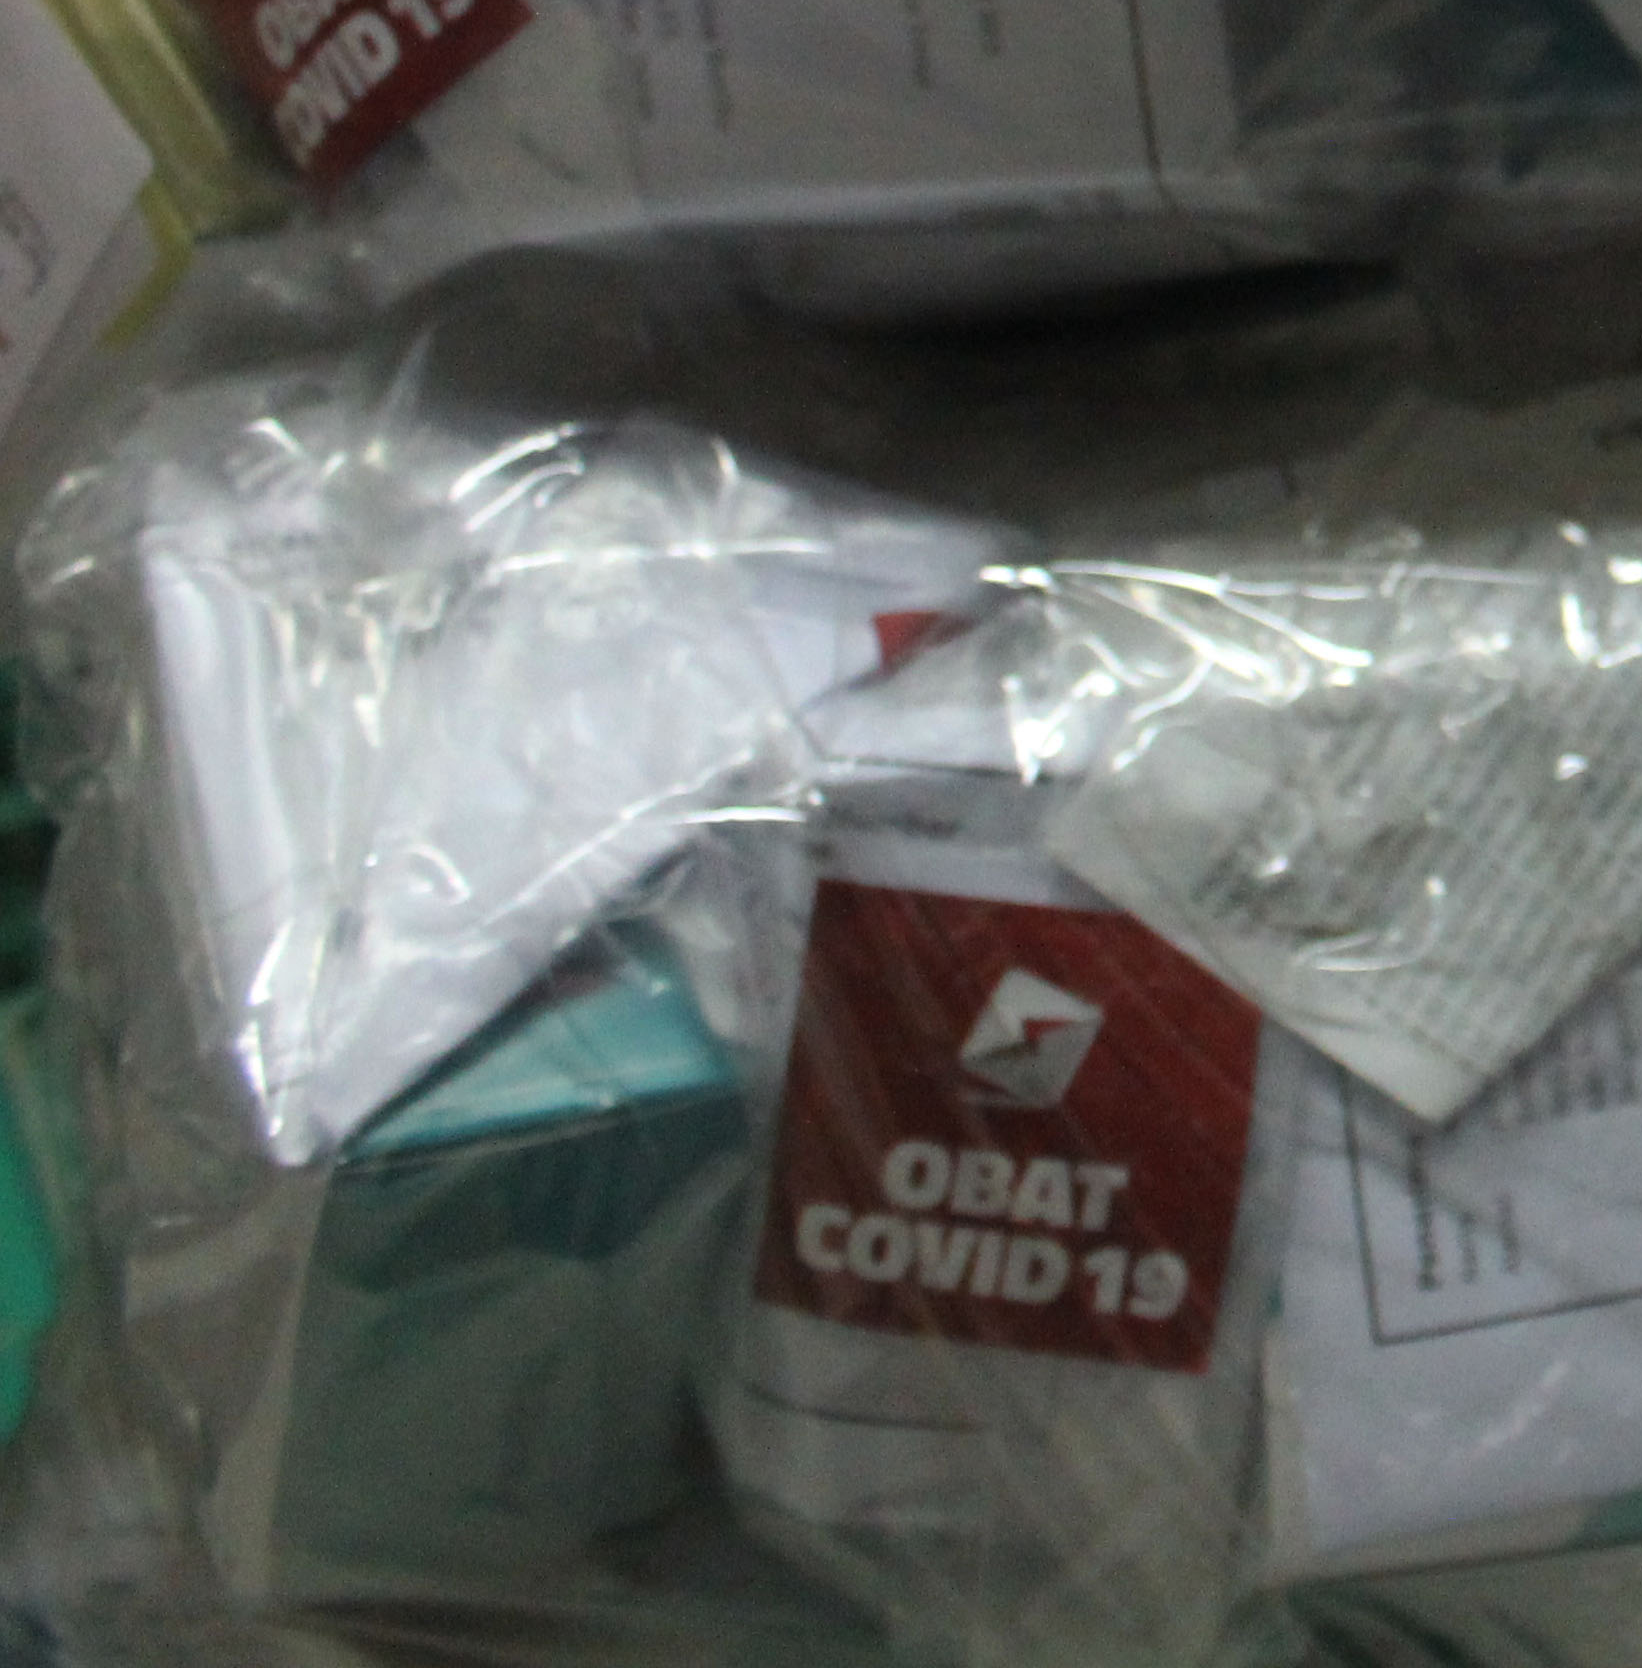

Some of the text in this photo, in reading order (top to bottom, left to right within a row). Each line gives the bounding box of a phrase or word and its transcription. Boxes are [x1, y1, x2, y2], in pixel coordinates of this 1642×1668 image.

[880, 1139, 1131, 1231] OBAT
[796, 1202, 1191, 1322] COVID 19
